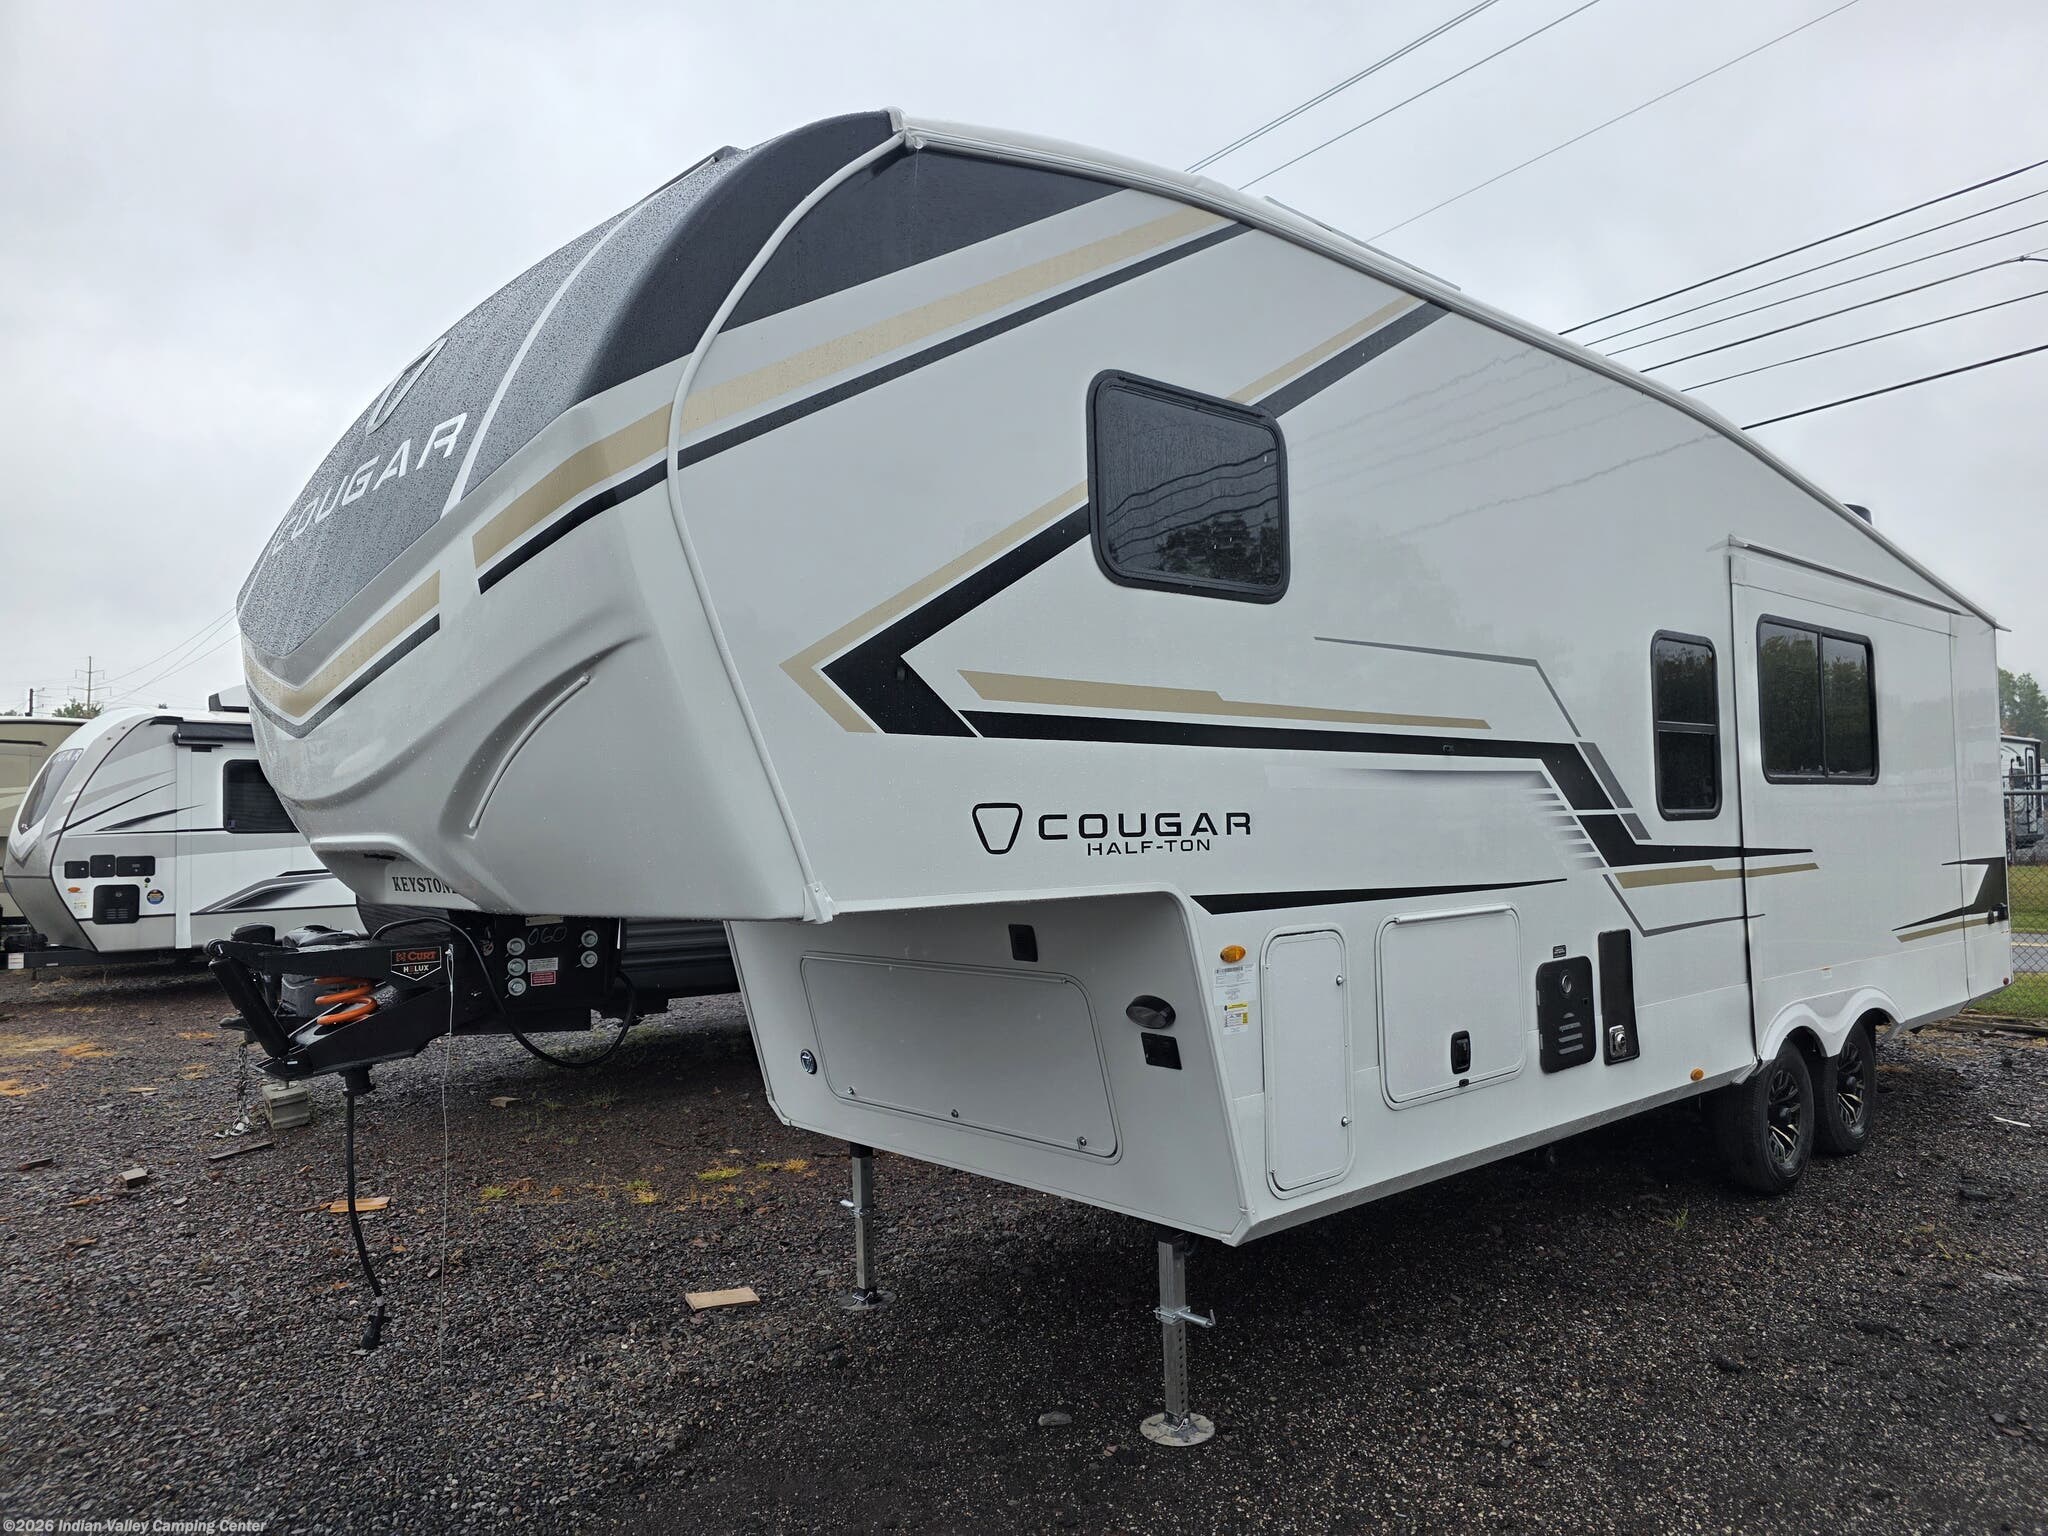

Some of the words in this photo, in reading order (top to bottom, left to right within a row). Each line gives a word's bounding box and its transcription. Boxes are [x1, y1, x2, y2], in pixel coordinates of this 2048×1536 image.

[271, 412, 468, 557] COUGAR
[1038, 812, 1251, 841] COUGAR
[1087, 839, 1210, 856] HALF-TON
[392, 876, 458, 894] KEYSTON
